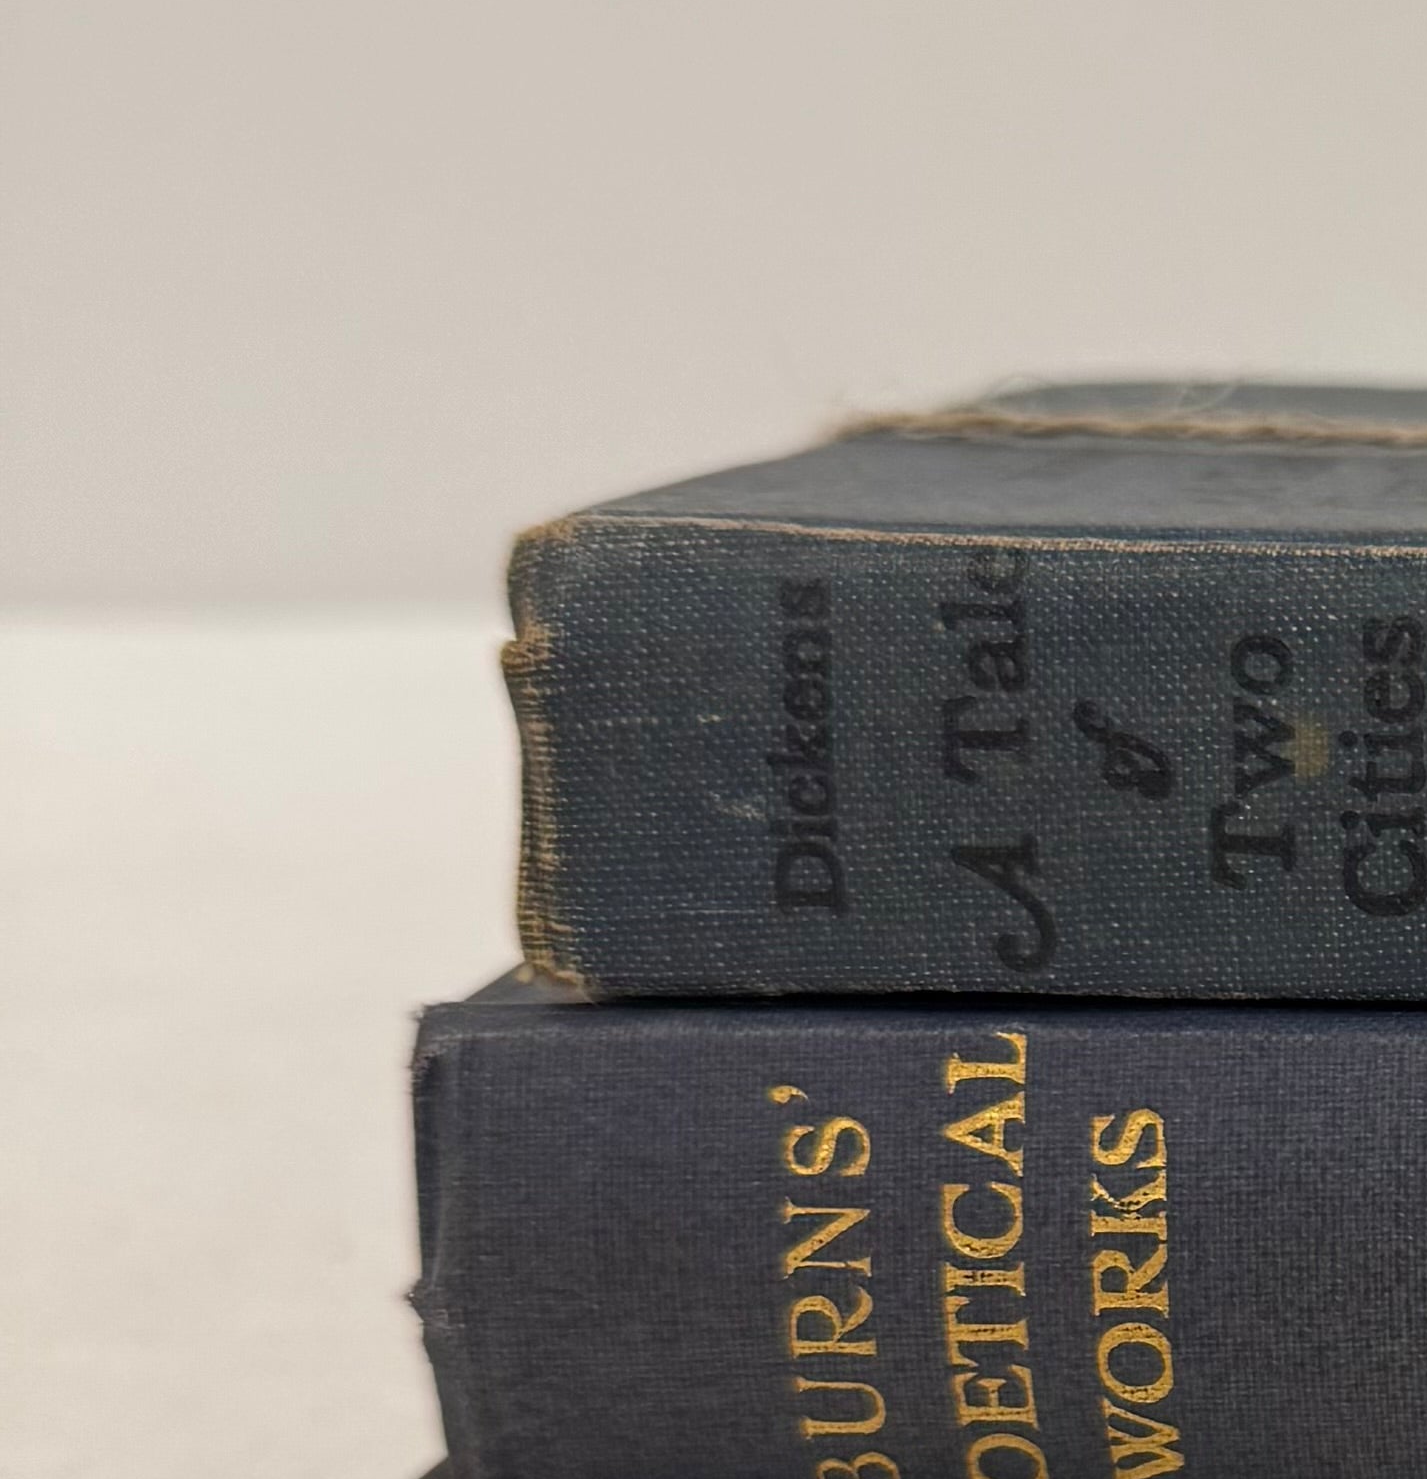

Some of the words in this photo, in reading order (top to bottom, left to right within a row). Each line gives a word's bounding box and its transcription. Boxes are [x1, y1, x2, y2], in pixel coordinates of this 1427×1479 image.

[768, 575, 850, 919] Dickens
[939, 548, 1030, 784] Tale
[1211, 634, 1311, 891] Two
[951, 832, 1057, 972] A
